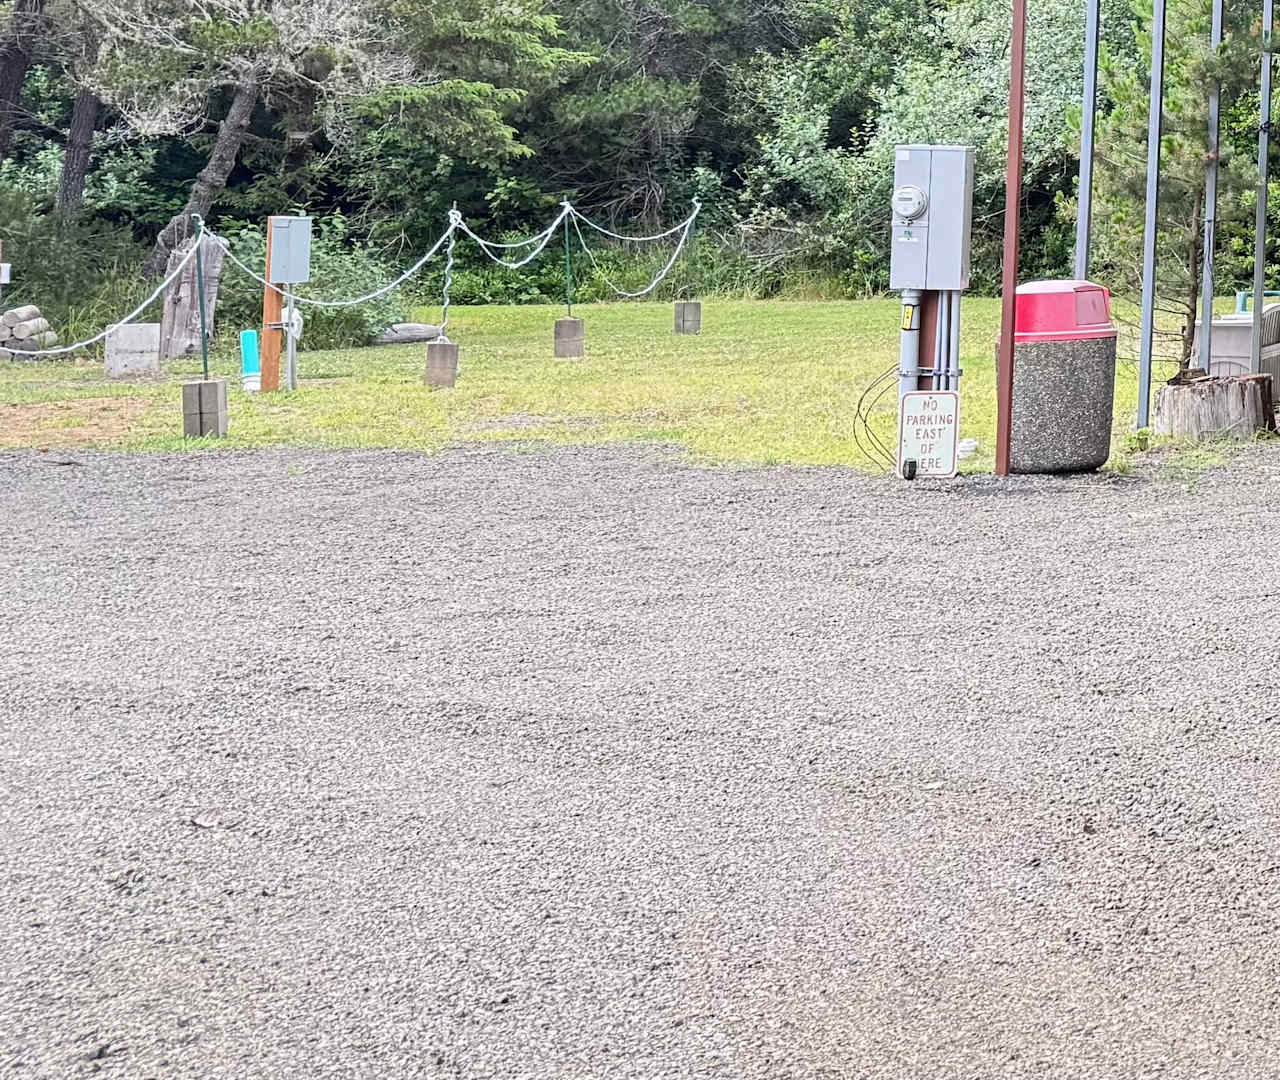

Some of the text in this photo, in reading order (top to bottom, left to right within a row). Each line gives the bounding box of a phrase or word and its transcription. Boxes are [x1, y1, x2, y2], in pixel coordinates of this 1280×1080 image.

[922, 400, 938, 410] NO
[906, 414, 953, 425] PARKING
[915, 428, 944, 439] EAST
[920, 443, 935, 454] OF
